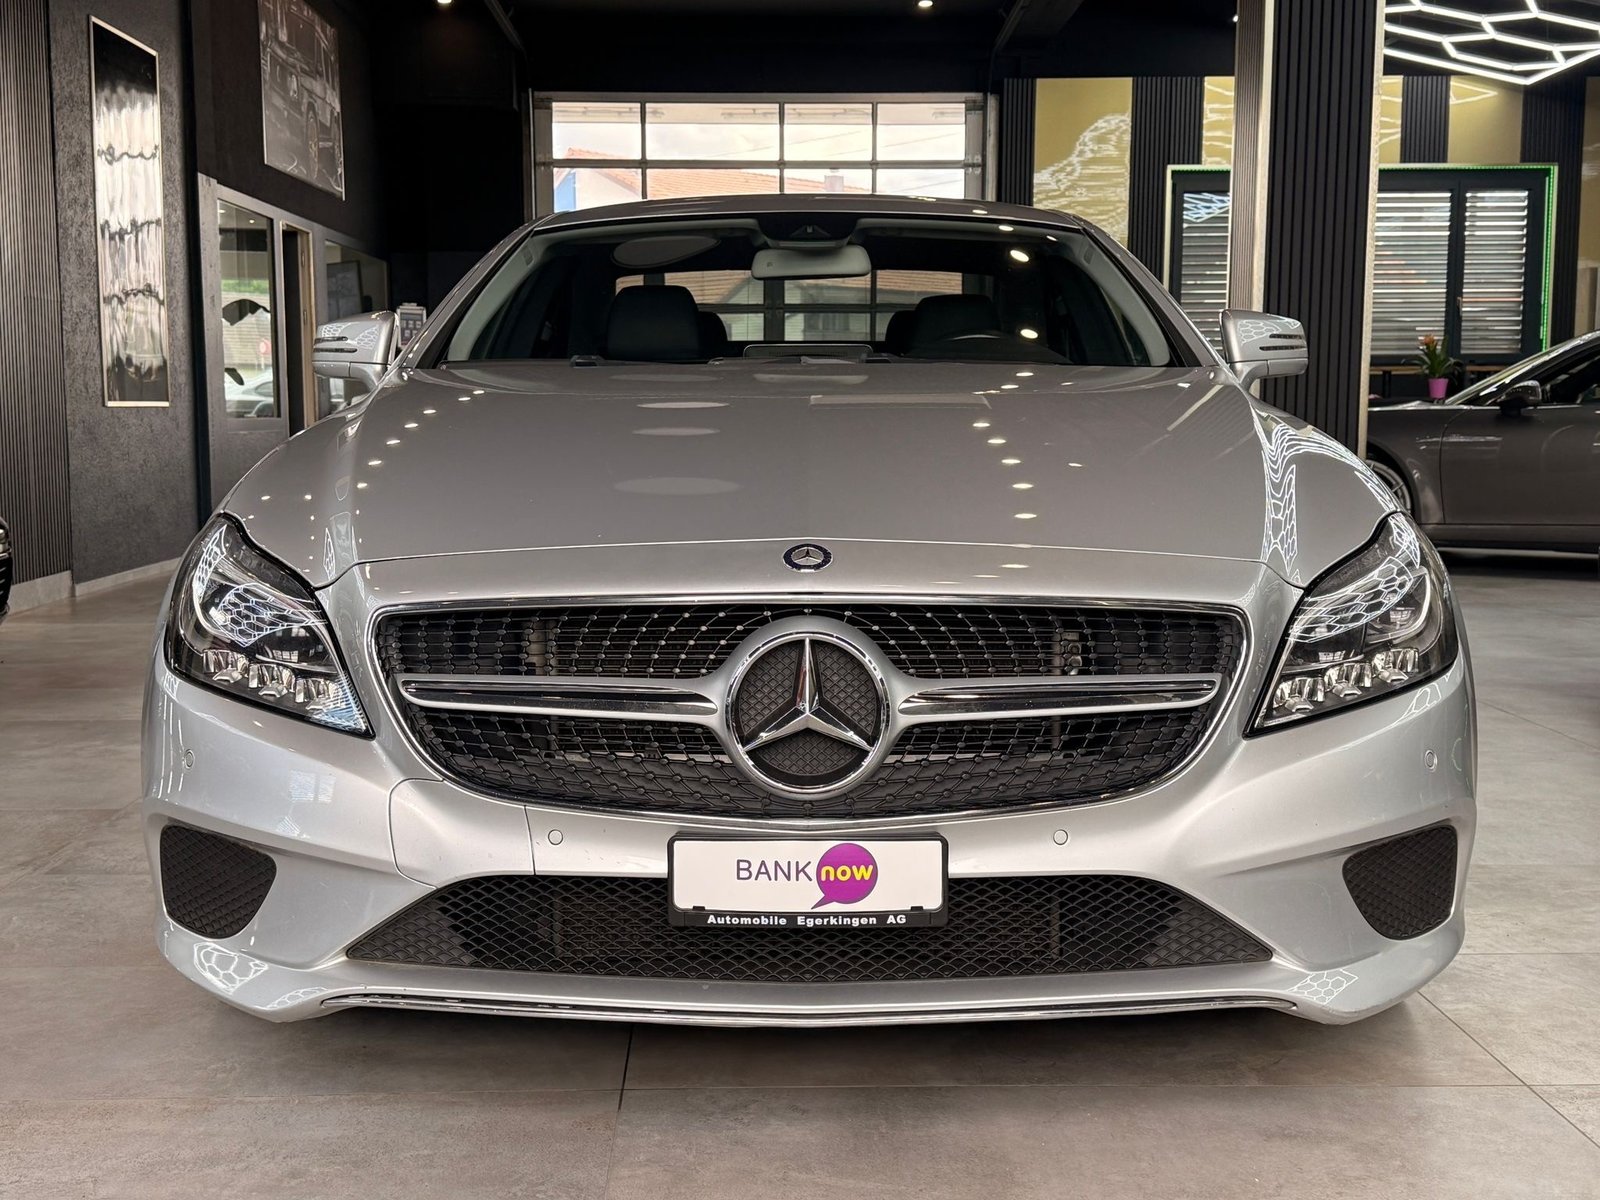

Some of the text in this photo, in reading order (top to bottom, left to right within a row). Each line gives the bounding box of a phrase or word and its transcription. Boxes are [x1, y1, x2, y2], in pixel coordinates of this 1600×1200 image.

[736, 859, 873, 882] BANK now
[707, 914, 907, 927] Automobile Egerkingen AG
